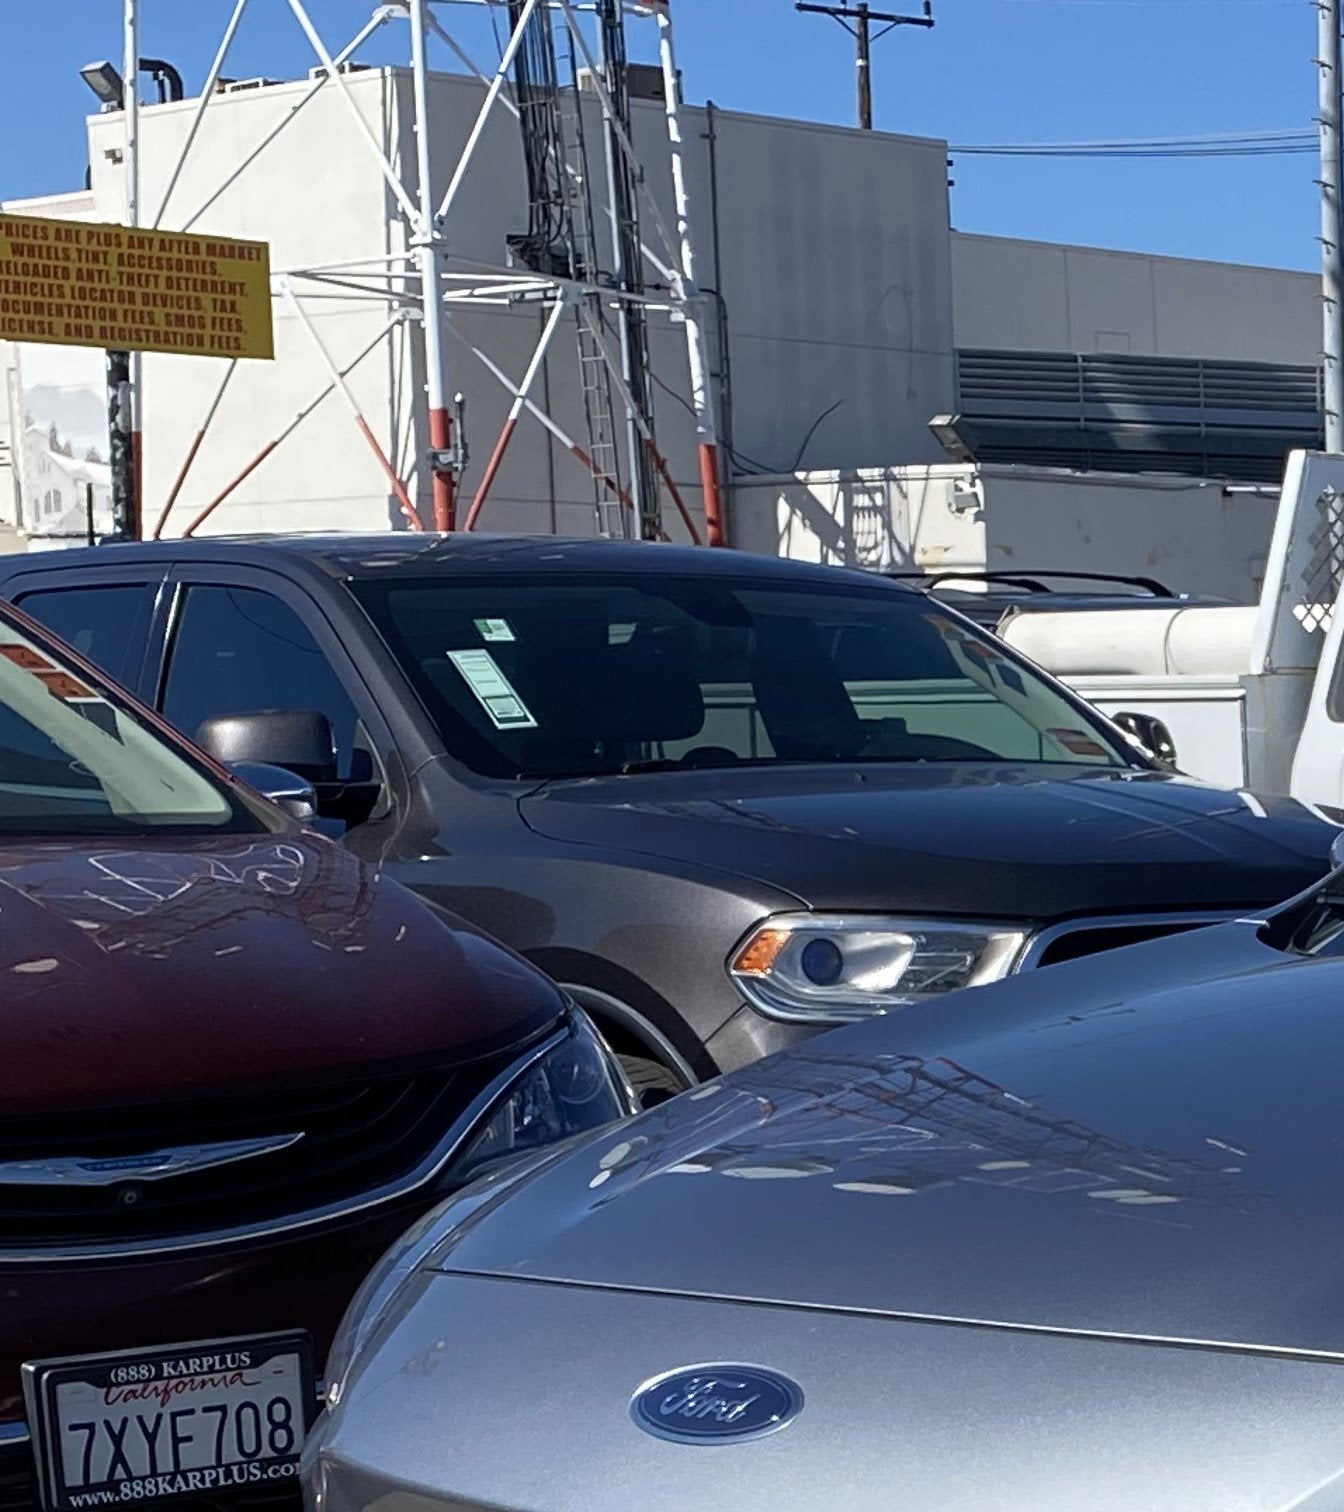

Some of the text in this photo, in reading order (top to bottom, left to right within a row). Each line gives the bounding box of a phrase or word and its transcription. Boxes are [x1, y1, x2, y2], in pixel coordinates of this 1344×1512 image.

[55, 227, 82, 245] ARE
[86, 230, 122, 248] PLUS
[127, 235, 154, 252] ANY
[159, 238, 201, 257] AFTER
[206, 242, 261, 262] MARKET
[0, 279, 66, 299] EHICLES
[70, 285, 136, 306] LOCATOR
[0, 298, 118, 322] OCUMENTATION
[164, 311, 206, 330] SMOG
[64, 322, 94, 340] AND
[99, 325, 205, 348] REGISTRATION
[110, 1351, 251, 1383] (888) KARPLUS
[659, 1375, 762, 1424] Ford
[68, 1396, 295, 1486] 7XYF708
